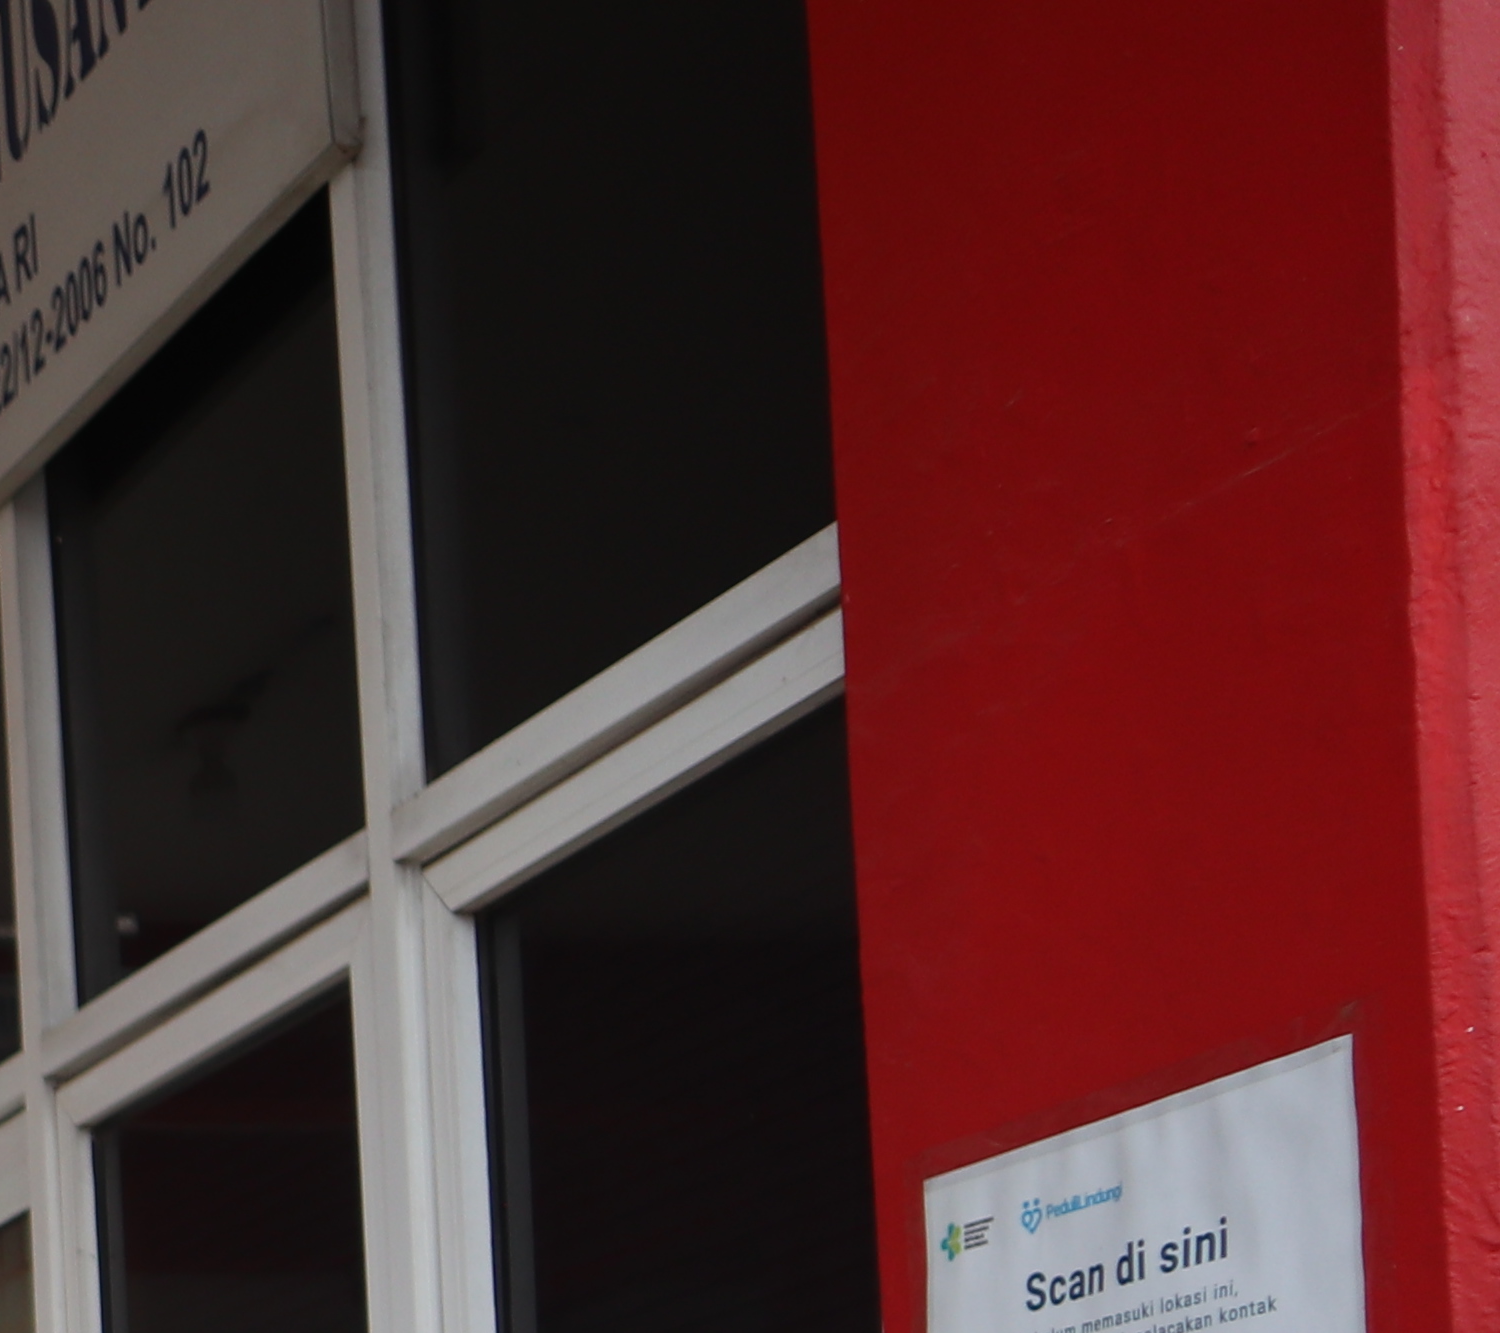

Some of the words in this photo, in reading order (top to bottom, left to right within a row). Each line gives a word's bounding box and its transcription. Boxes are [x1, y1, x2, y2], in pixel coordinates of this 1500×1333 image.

[111, 210, 157, 286] No.
[162, 128, 212, 230] 102
[13, 212, 39, 293] RI
[1025, 1262, 1104, 1312] Scan
[1116, 1240, 1146, 1288] di
[1159, 1216, 1228, 1274] sini
[1159, 1286, 1207, 1314] lokasi
[1213, 1279, 1239, 1301] ini,
[1218, 1294, 1277, 1324] kontak
